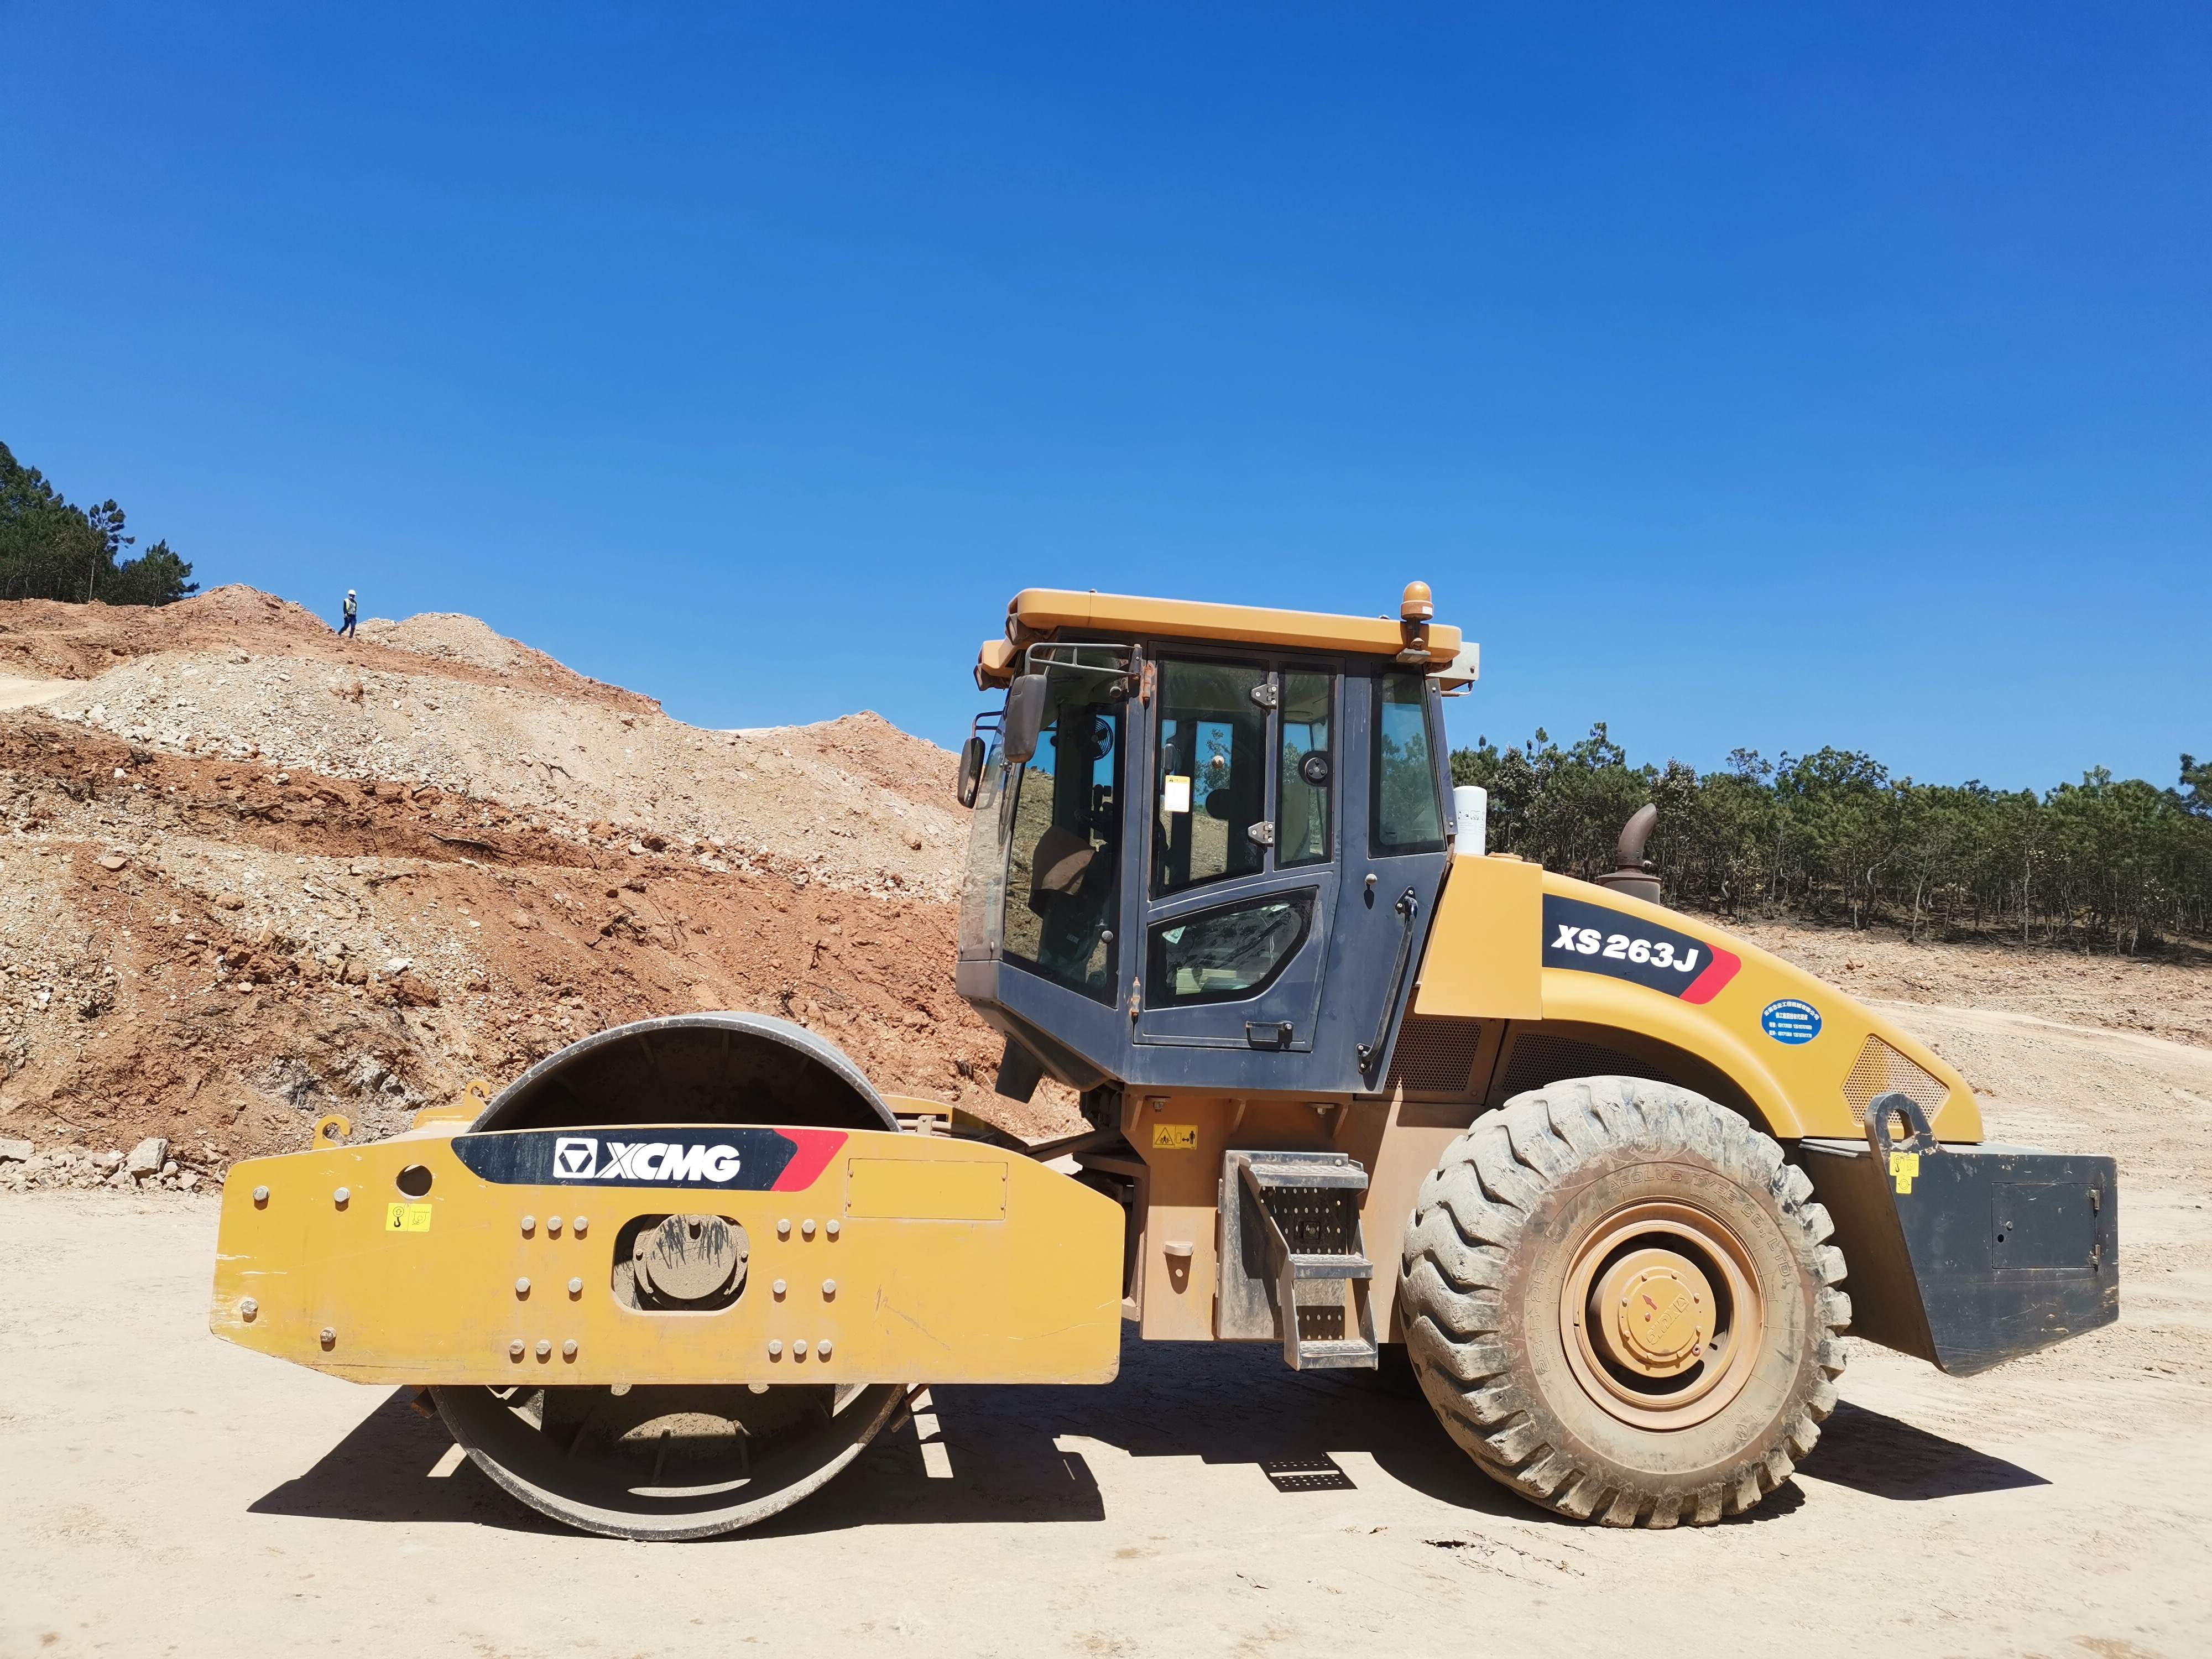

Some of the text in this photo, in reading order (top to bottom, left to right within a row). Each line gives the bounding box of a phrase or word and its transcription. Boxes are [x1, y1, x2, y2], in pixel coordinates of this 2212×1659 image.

[1551, 924, 1699, 973] XS 263J
[594, 1142, 740, 1182] XCMG
[1610, 1167, 1683, 1191] AEOLUS
